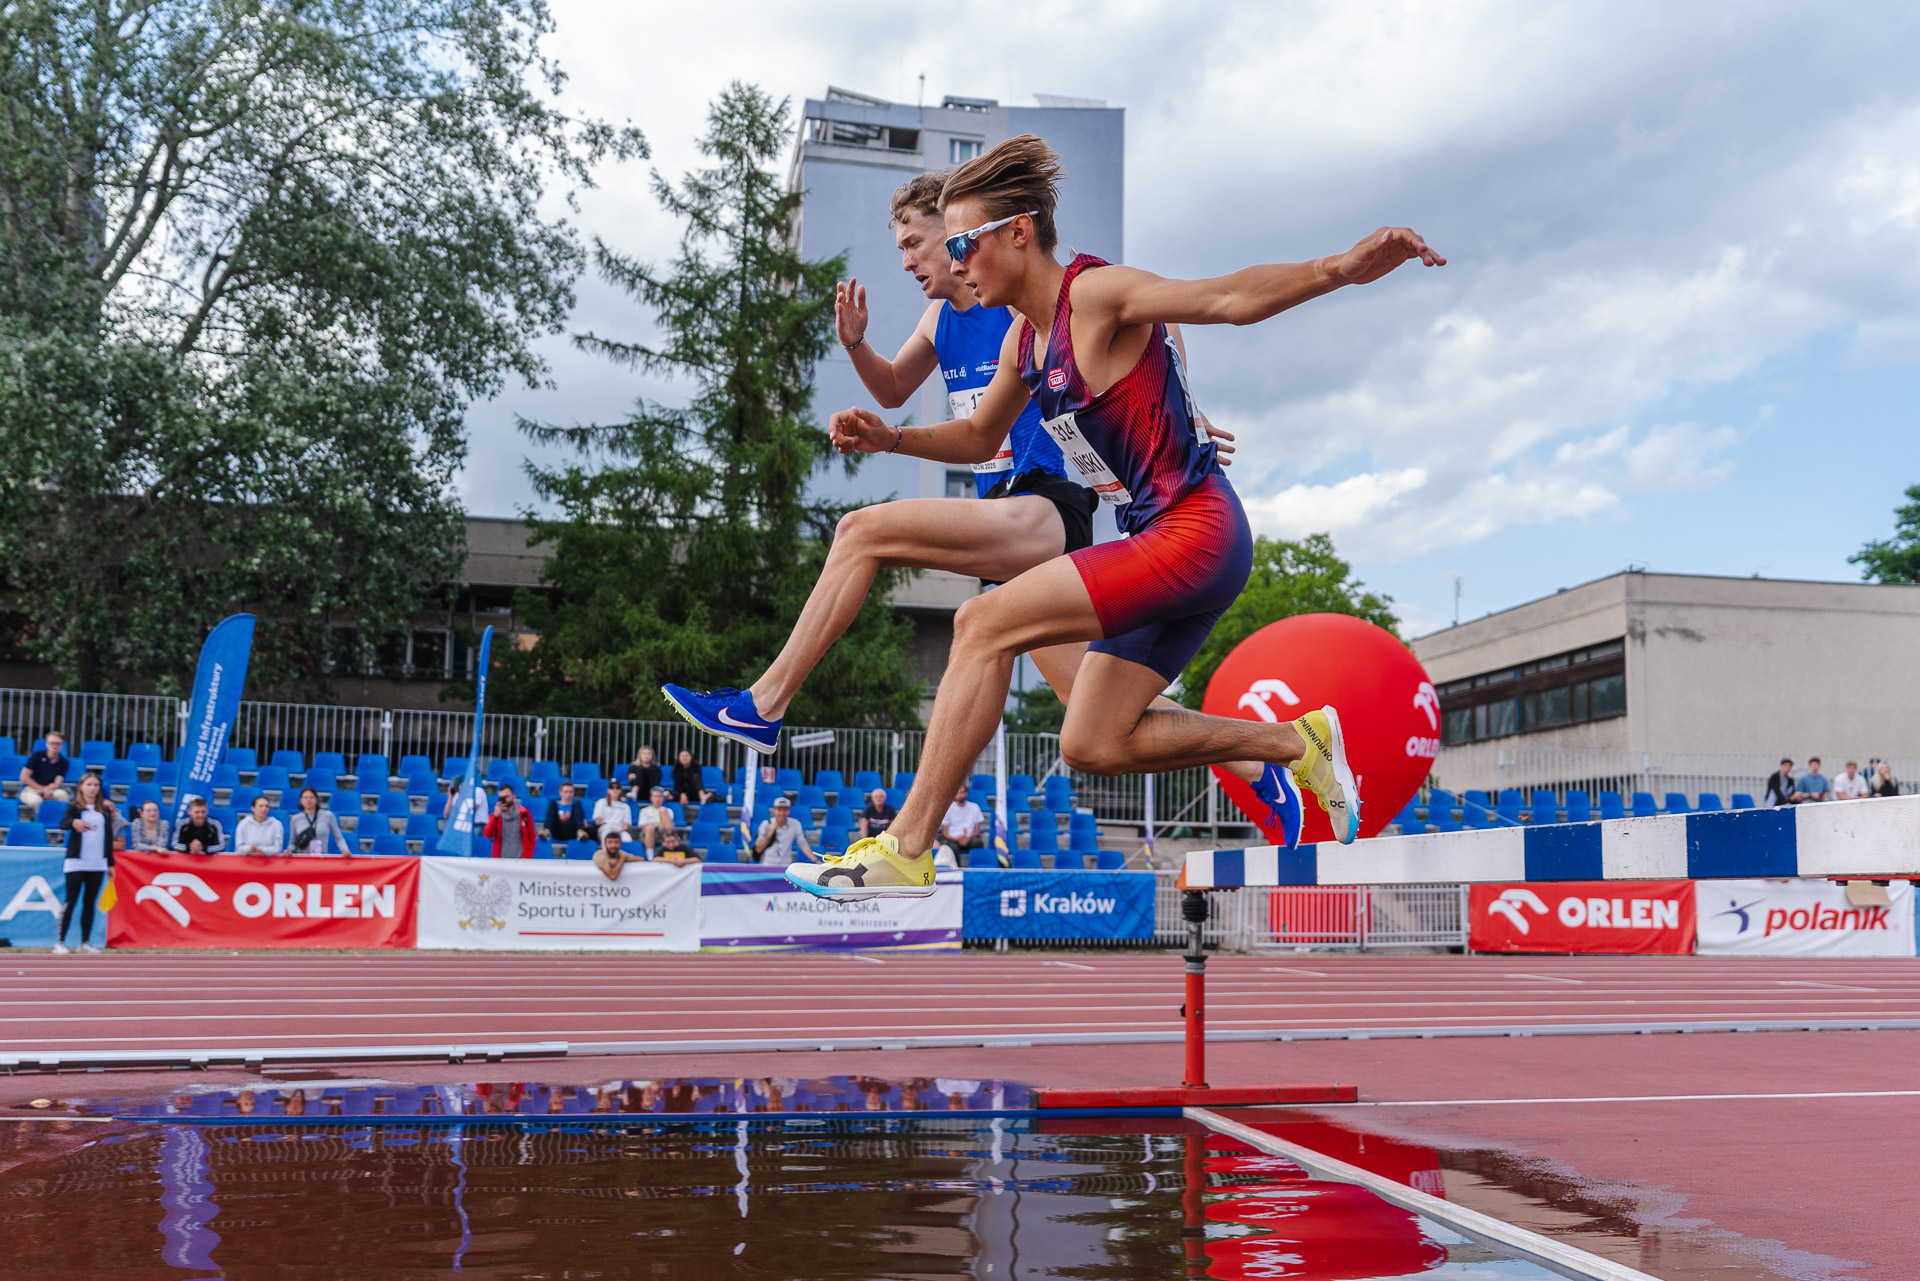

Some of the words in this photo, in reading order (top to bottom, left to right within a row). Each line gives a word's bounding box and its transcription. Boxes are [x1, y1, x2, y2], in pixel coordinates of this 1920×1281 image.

[1052, 420, 1078, 442] 314
[189, 741, 208, 780] Zarząd
[199, 662, 223, 741] Infrastruktury
[1297, 716, 1326, 752] RUNNING
[232, 881, 396, 919] ORLEN
[519, 881, 631, 898] Ministerstwo
[518, 902, 575, 920] Sportu
[580, 903, 585, 918] i
[590, 903, 667, 921] Turystyki
[786, 901, 880, 914] MAŁOPOLSKA
[1034, 891, 1116, 914] Kraków
[1558, 896, 1679, 929] ORLEN
[818, 918, 844, 928] Arena
[1763, 900, 1891, 937] polanik
